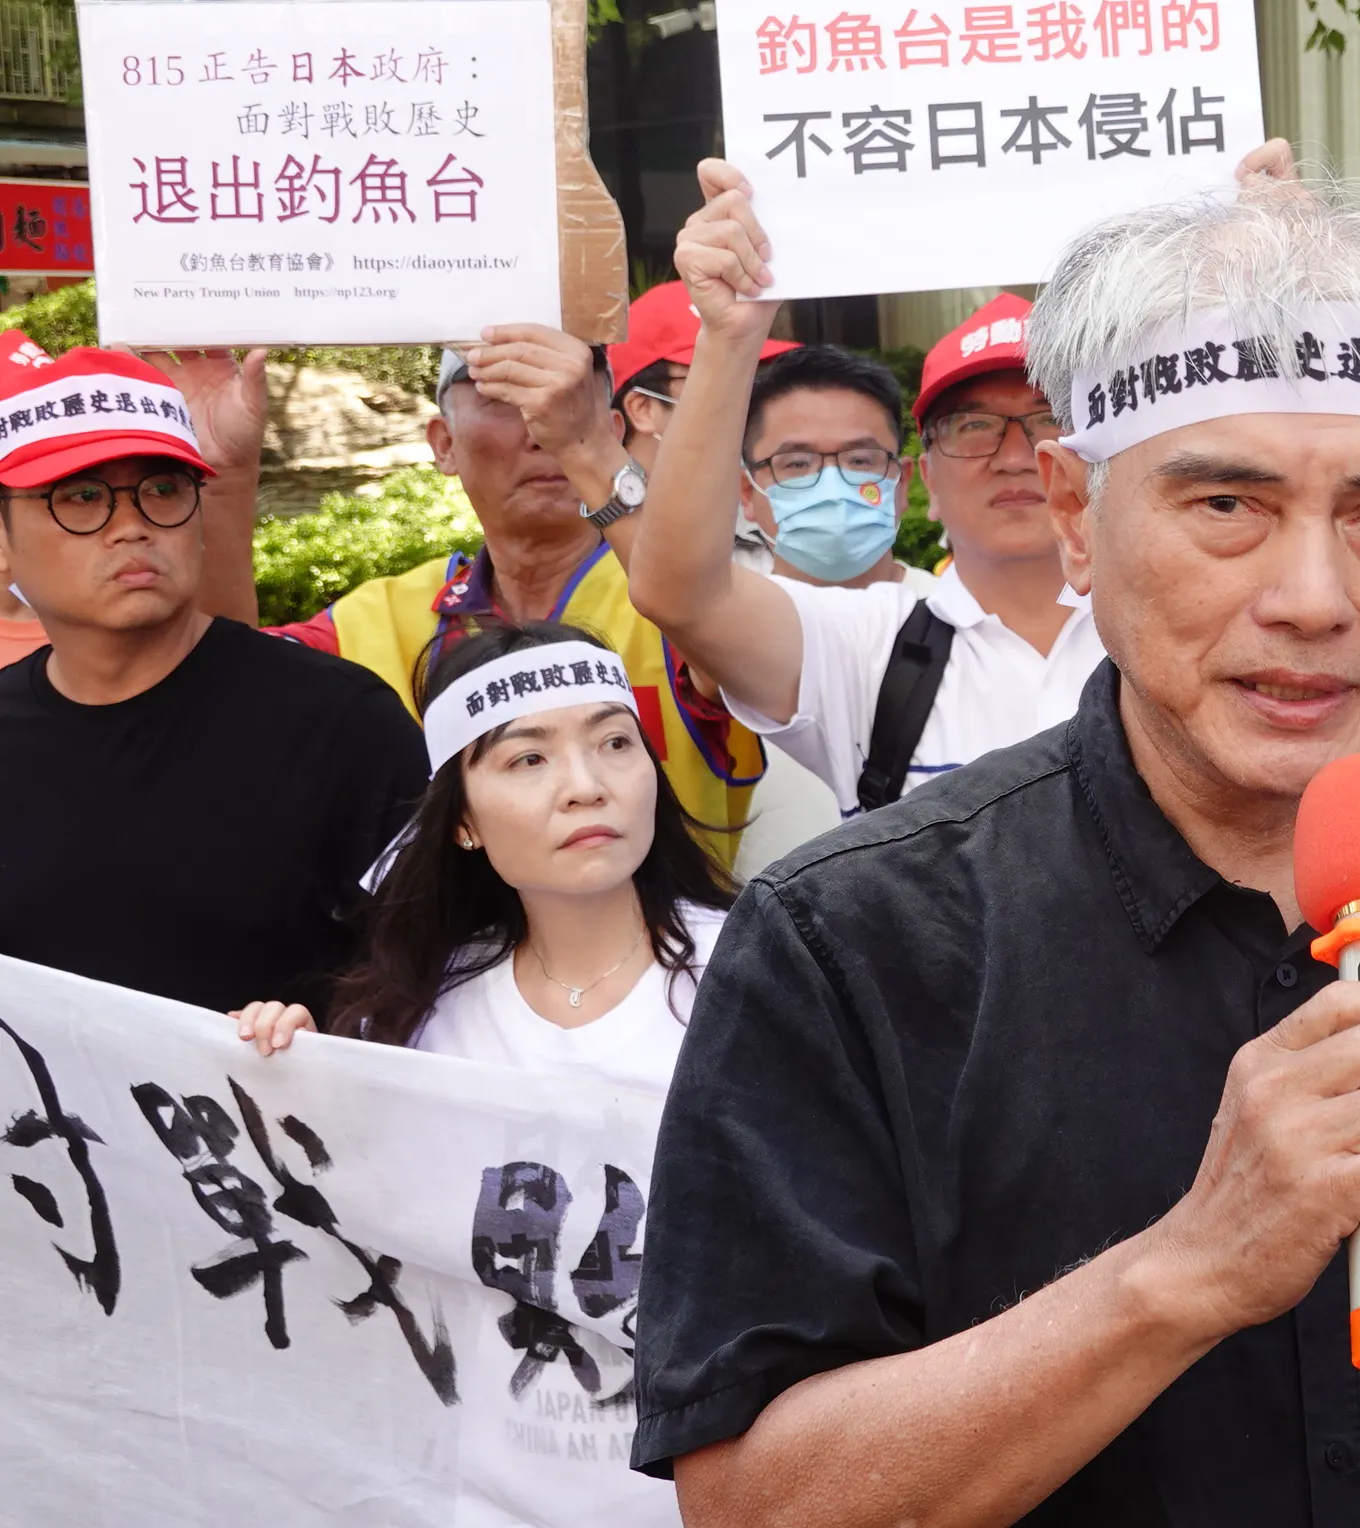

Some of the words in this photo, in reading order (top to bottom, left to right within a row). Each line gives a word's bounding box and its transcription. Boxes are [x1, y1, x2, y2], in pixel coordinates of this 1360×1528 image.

[756, 0, 1221, 76] 釣魚台是我們的
[122, 55, 185, 86] 815
[198, 46, 480, 88] 正告日本政府：
[236, 99, 486, 140] 面對戰敗歷史
[762, 86, 1226, 178] 不容日本侵佔
[129, 152, 484, 225] 退出釣魚台
[0, 203, 45, 254] 麵
[178, 252, 336, 272] 《釣魚台教育協會》
[353, 255, 518, 273] https://diaoyutai.tw/
[133, 287, 159, 298] New
[163, 287, 197, 301] Party
[200, 287, 241, 301] Trump
[244, 287, 280, 298] Union
[294, 286, 398, 301] https://np123.org/
[960, 317, 1028, 358] 勞動
